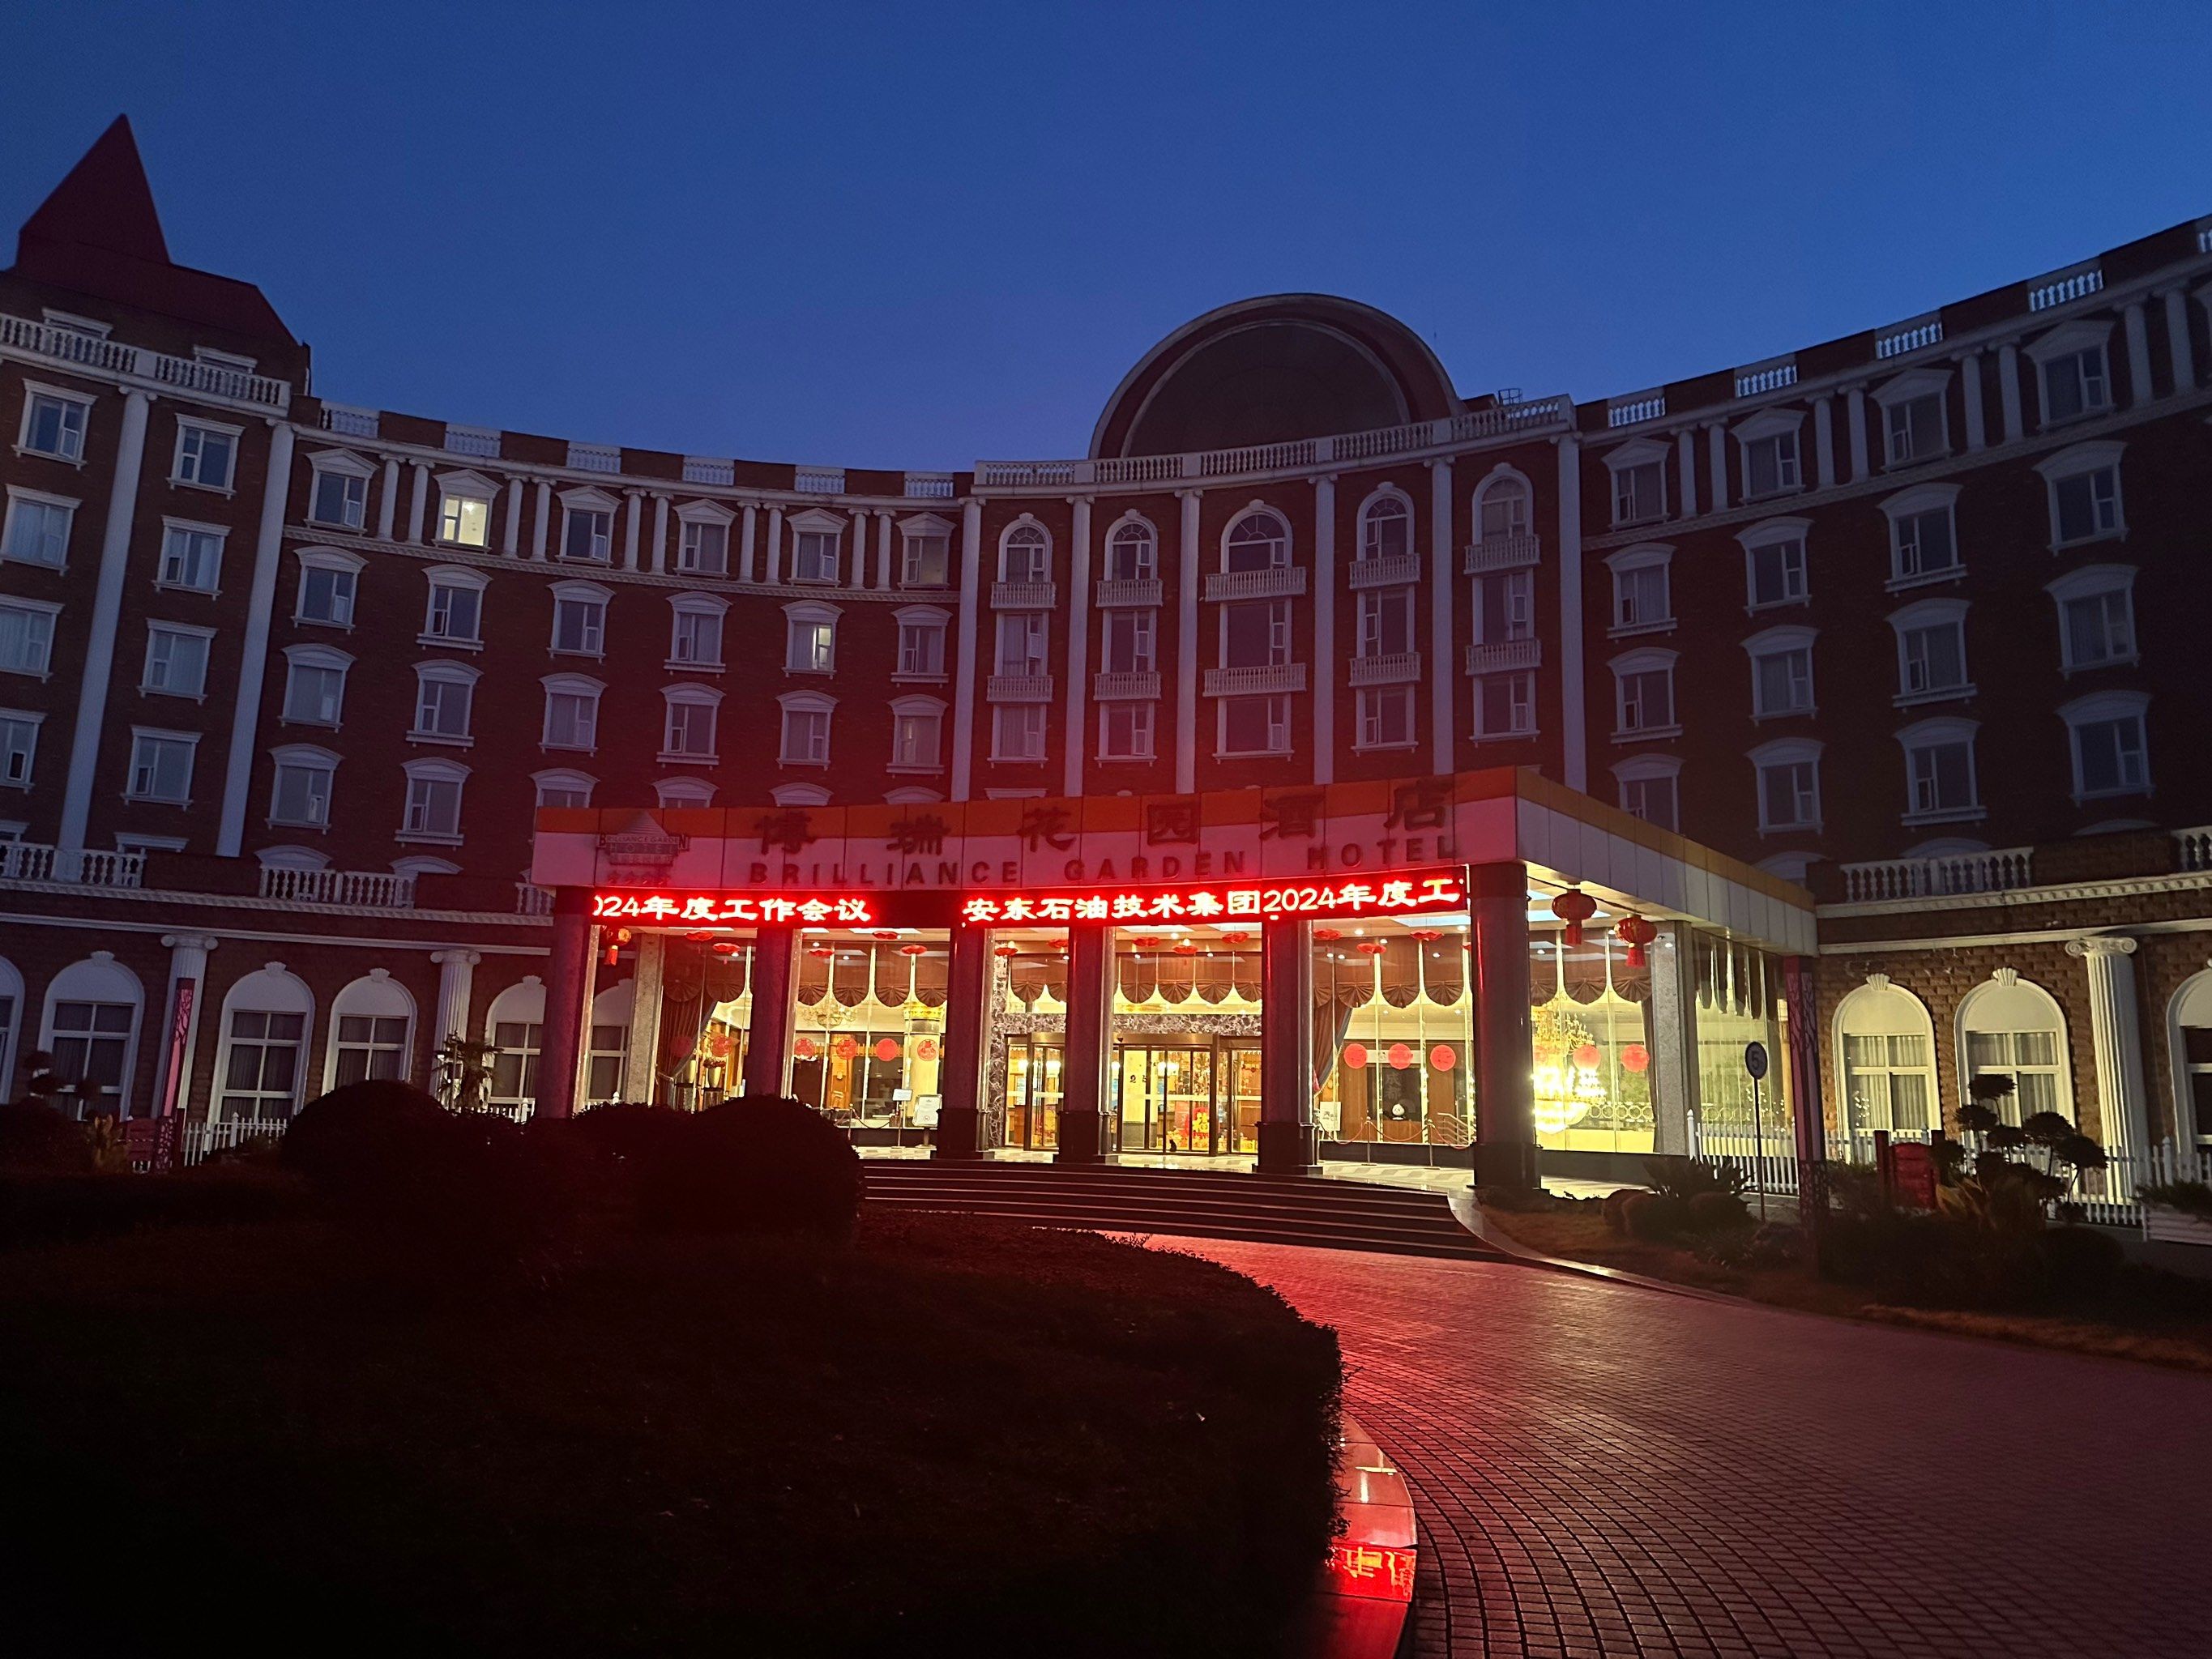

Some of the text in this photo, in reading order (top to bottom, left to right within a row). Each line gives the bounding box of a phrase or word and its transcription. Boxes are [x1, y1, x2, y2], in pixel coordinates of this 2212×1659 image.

[749, 835, 1453, 885] BRILLIANCE GARDEN HOTEL
[1751, 1051, 1759, 1070] 5
